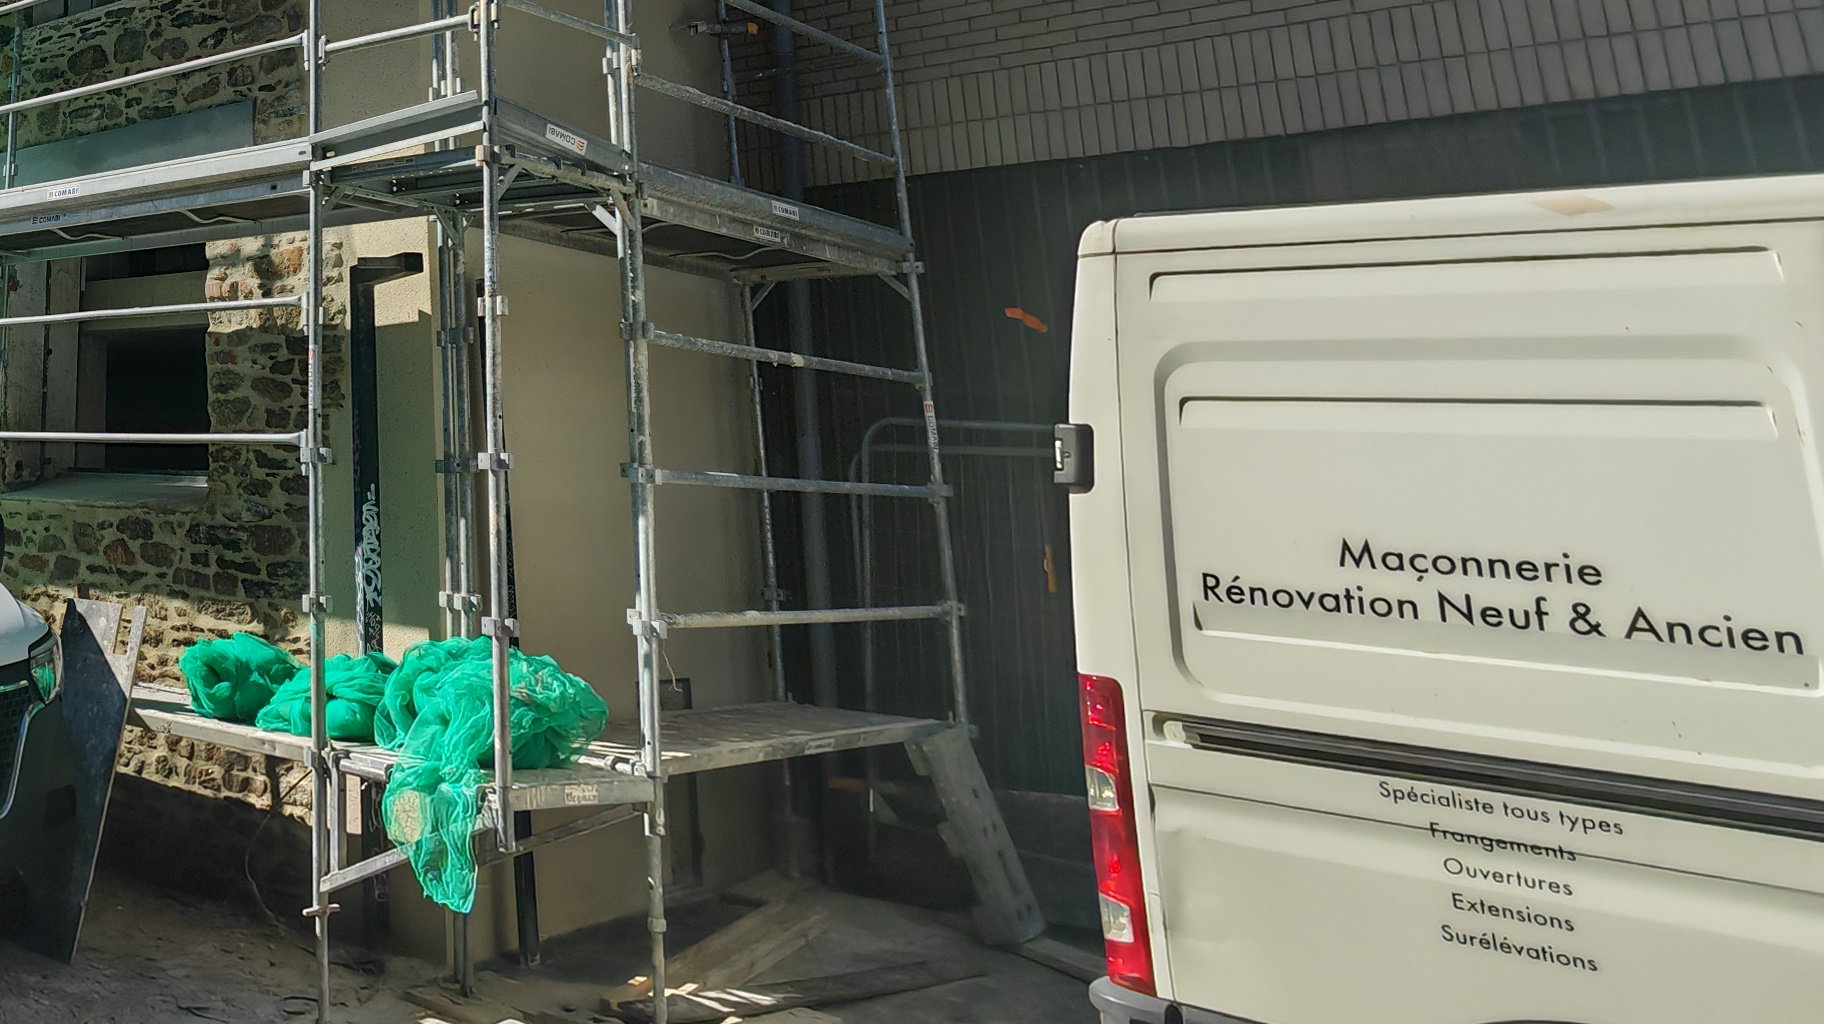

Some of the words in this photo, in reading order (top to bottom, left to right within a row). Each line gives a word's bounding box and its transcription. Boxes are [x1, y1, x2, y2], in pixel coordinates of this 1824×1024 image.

[548, 125, 576, 146] COMABI
[54, 187, 78, 198] COMABI
[38, 214, 61, 225] COMABI
[1338, 536, 1603, 586] Maçonnerie
[1201, 572, 1420, 620] Rénovation
[1436, 588, 1550, 632] Neuf
[1568, 601, 1608, 638] &
[1623, 606, 1804, 656] Ancien
[1378, 780, 1495, 815] Spécialiste
[1502, 801, 1551, 824] tous
[1558, 810, 1624, 836] types
[1442, 857, 1574, 896] Ouvertures
[1451, 891, 1576, 933] Extensions
[1440, 923, 1599, 972] Surélévations
